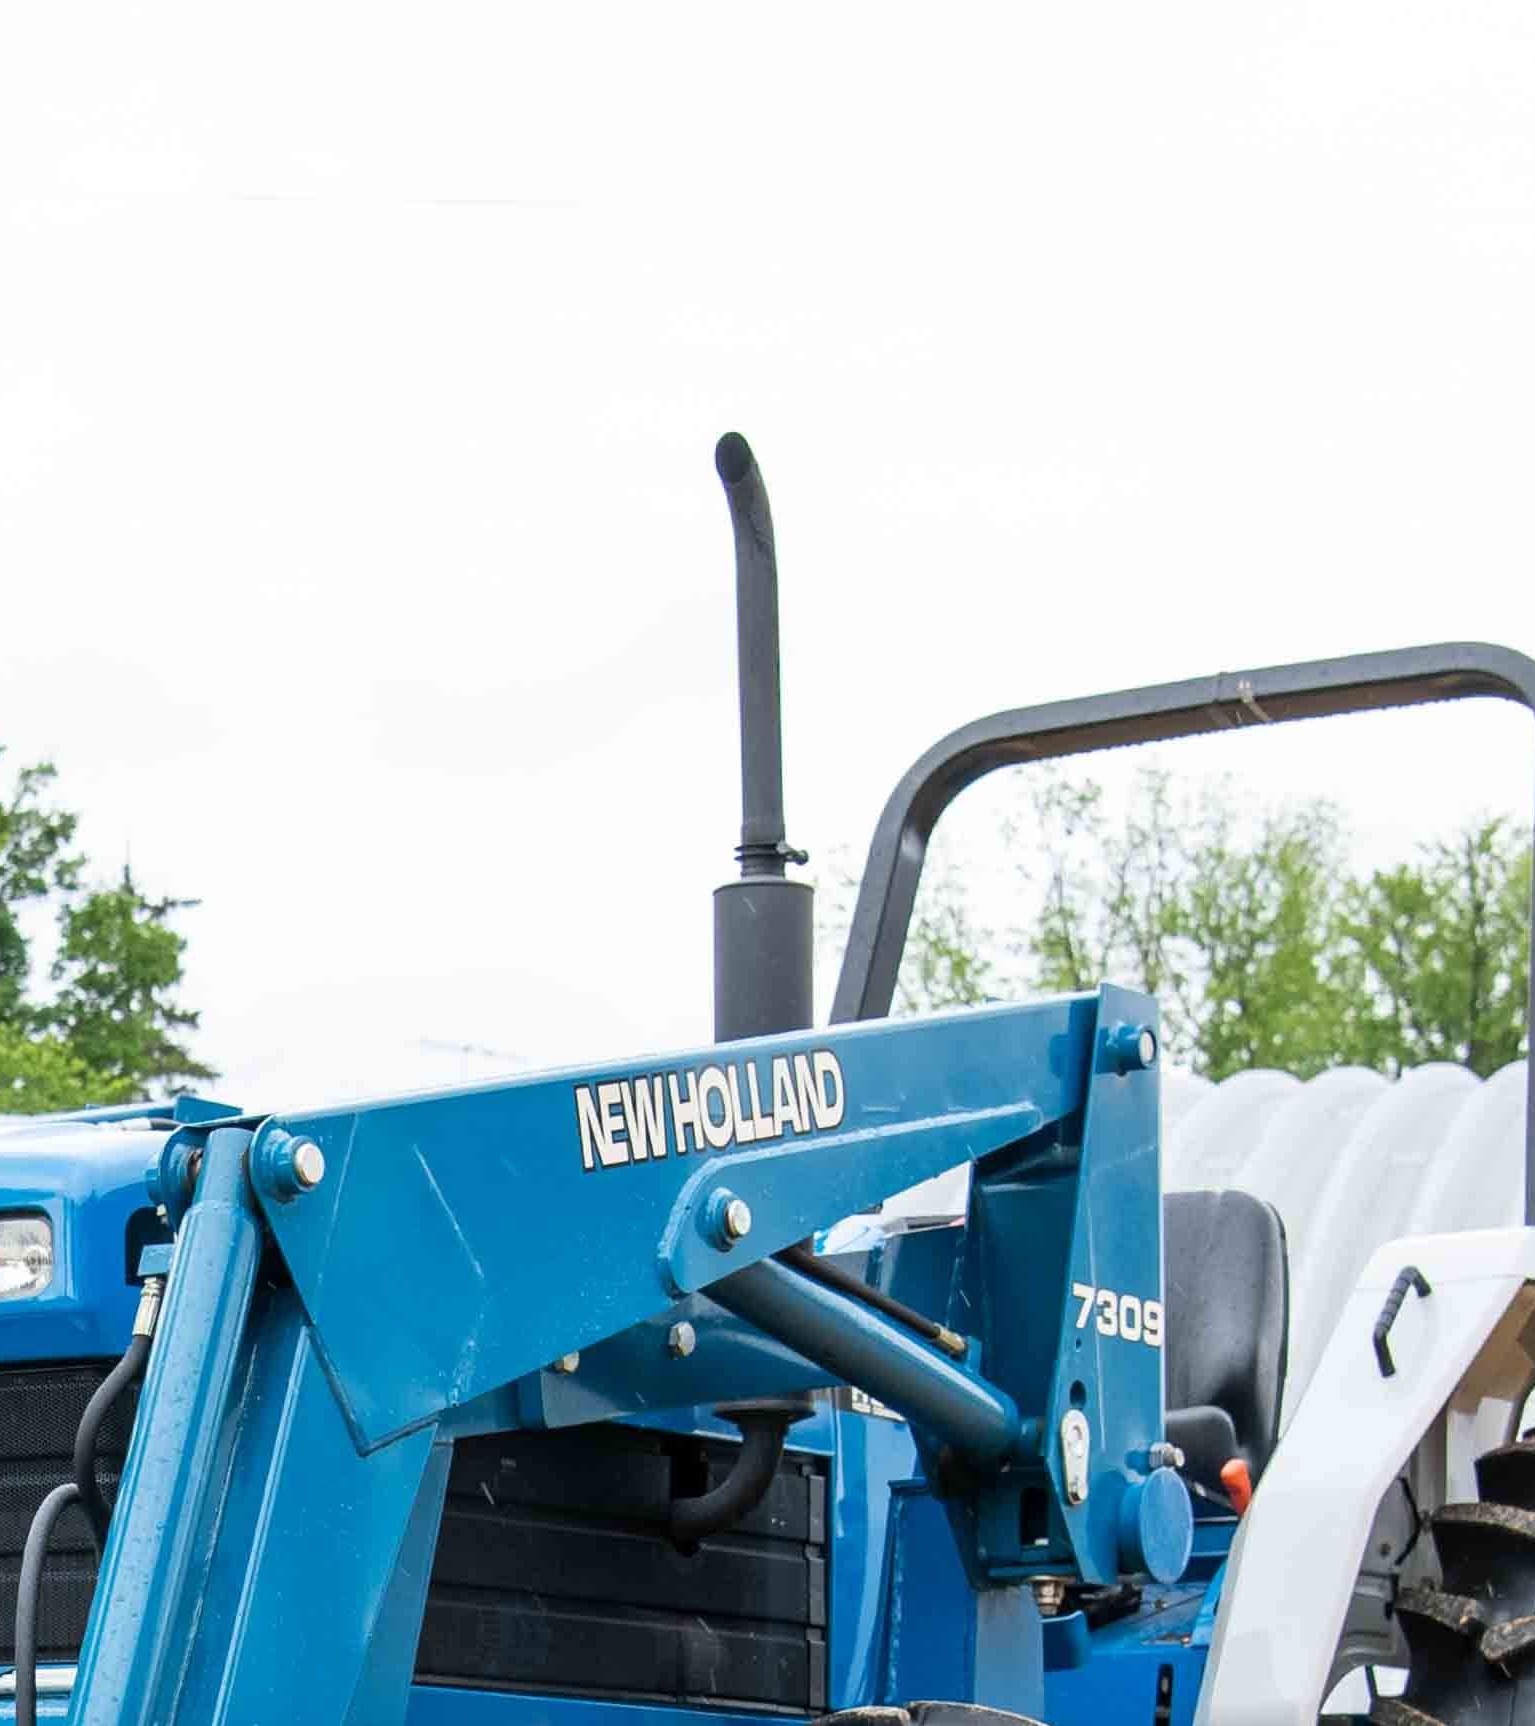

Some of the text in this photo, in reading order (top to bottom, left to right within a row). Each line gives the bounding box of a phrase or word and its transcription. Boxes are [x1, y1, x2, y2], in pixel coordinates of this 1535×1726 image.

[573, 1049, 845, 1171] NEW HOLLAND
[1072, 1281, 1165, 1347] 7309
